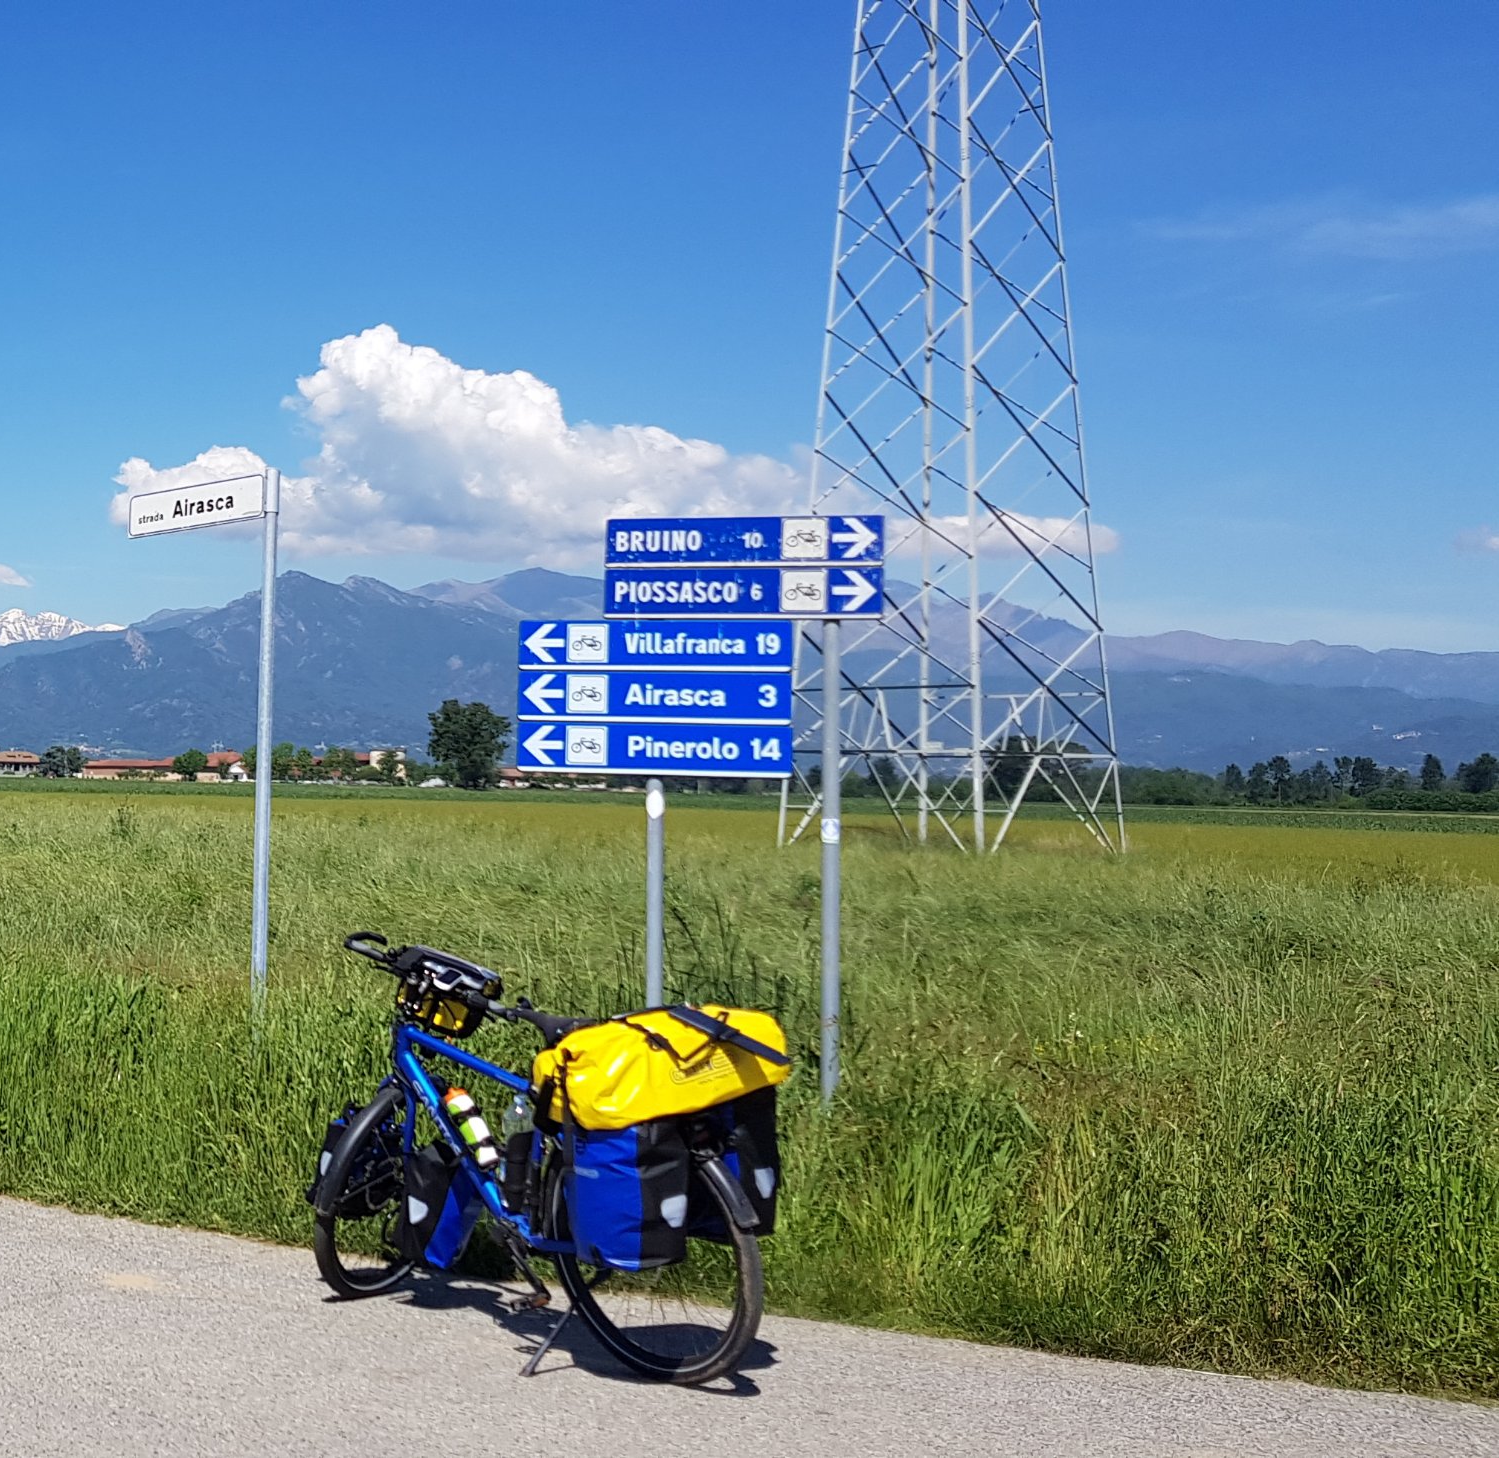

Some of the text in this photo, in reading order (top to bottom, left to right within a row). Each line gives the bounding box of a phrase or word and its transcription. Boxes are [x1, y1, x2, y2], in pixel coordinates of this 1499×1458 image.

[138, 495, 234, 525] strada Airasca
[615, 530, 764, 552] BRUINO 10
[614, 581, 764, 603] PIOSSASCO 6
[624, 632, 781, 655] Villafranca 19
[624, 683, 778, 708] Airasca 3
[627, 735, 782, 761] Pinerolo 14
